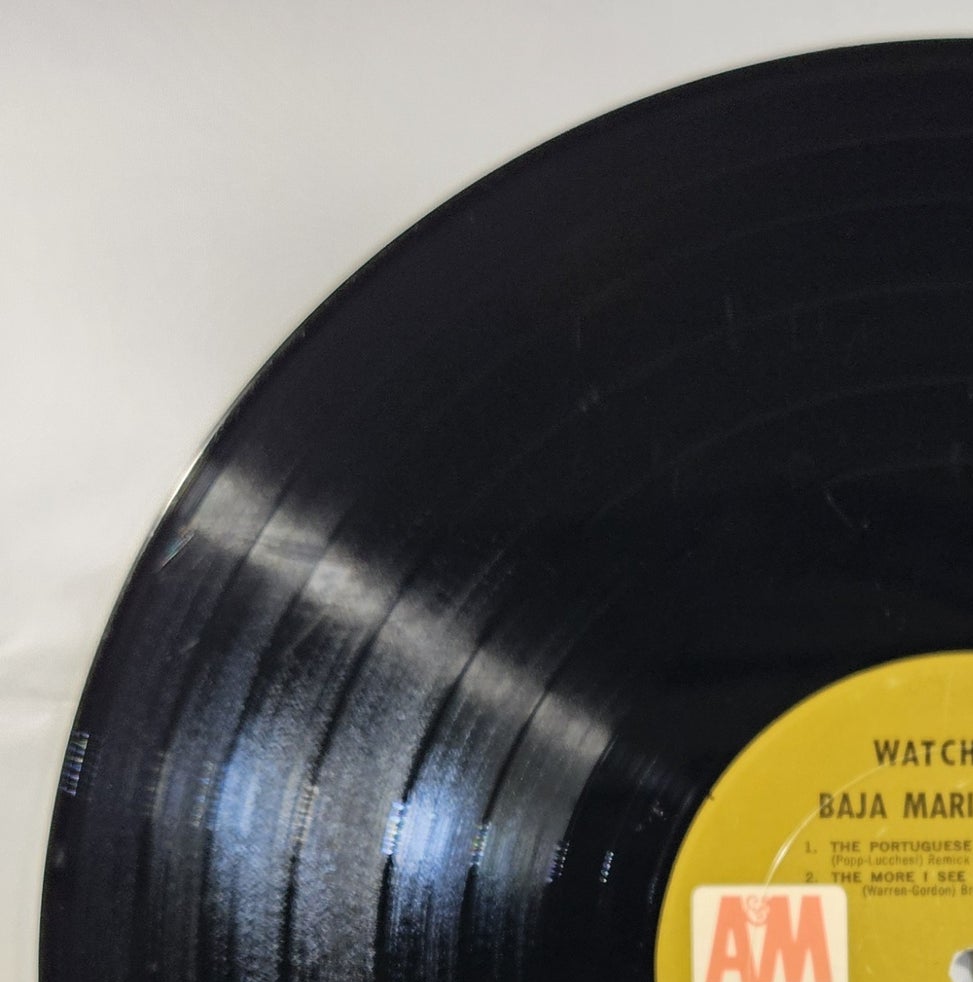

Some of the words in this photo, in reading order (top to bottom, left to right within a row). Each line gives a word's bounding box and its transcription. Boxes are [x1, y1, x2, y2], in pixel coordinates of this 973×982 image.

[819, 792, 887, 819] BAJA
[805, 841, 817, 854] 1.
[830, 840, 860, 853] THE
[870, 840, 972, 853] PORTUGUESE
[928, 854, 970, 866] Remick
[805, 871, 818, 883] 2.
[832, 871, 862, 883] THE
[871, 871, 915, 883] MORE
[924, 870, 928, 882] I
[938, 870, 965, 882] SEE
[863, 884, 956, 897] (Warren-Gordon)
